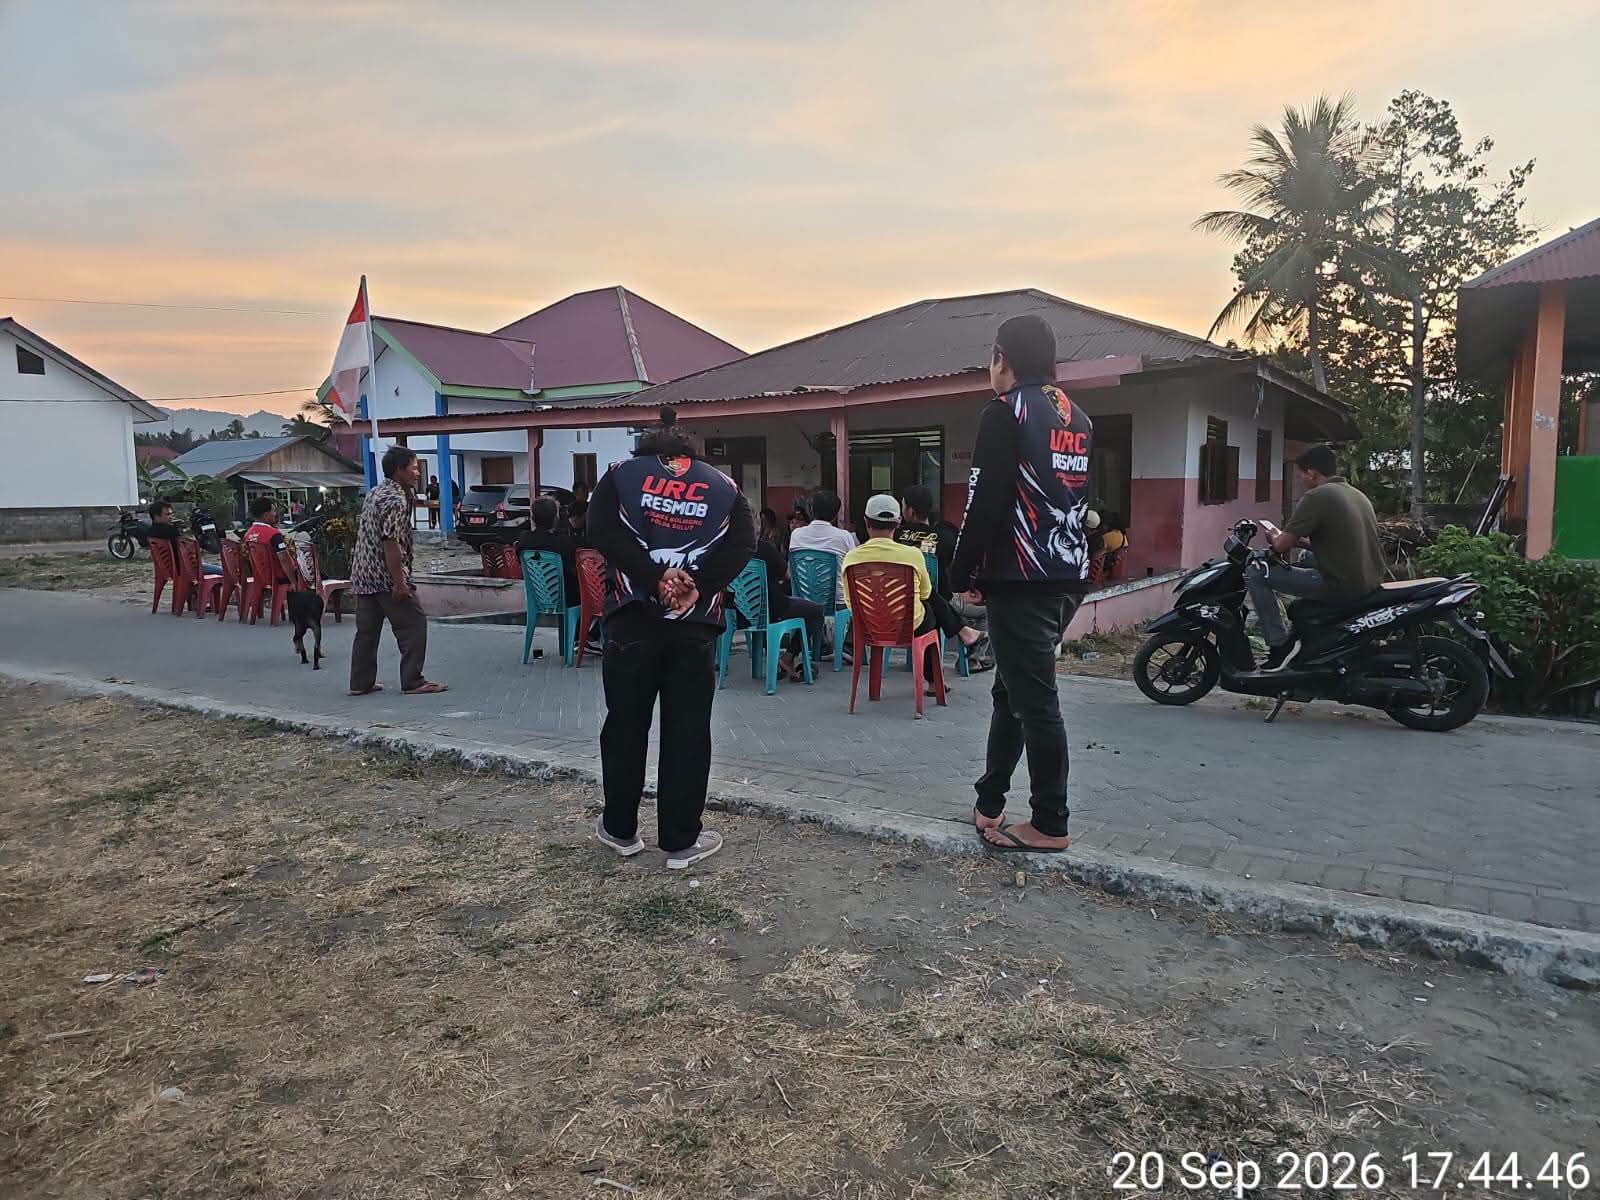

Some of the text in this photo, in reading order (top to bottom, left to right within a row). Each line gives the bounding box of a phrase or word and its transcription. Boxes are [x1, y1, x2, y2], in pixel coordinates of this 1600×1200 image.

[1049, 429, 1087, 454] URC
[642, 475, 709, 501] URC
[641, 493, 708, 517] RESMOB
